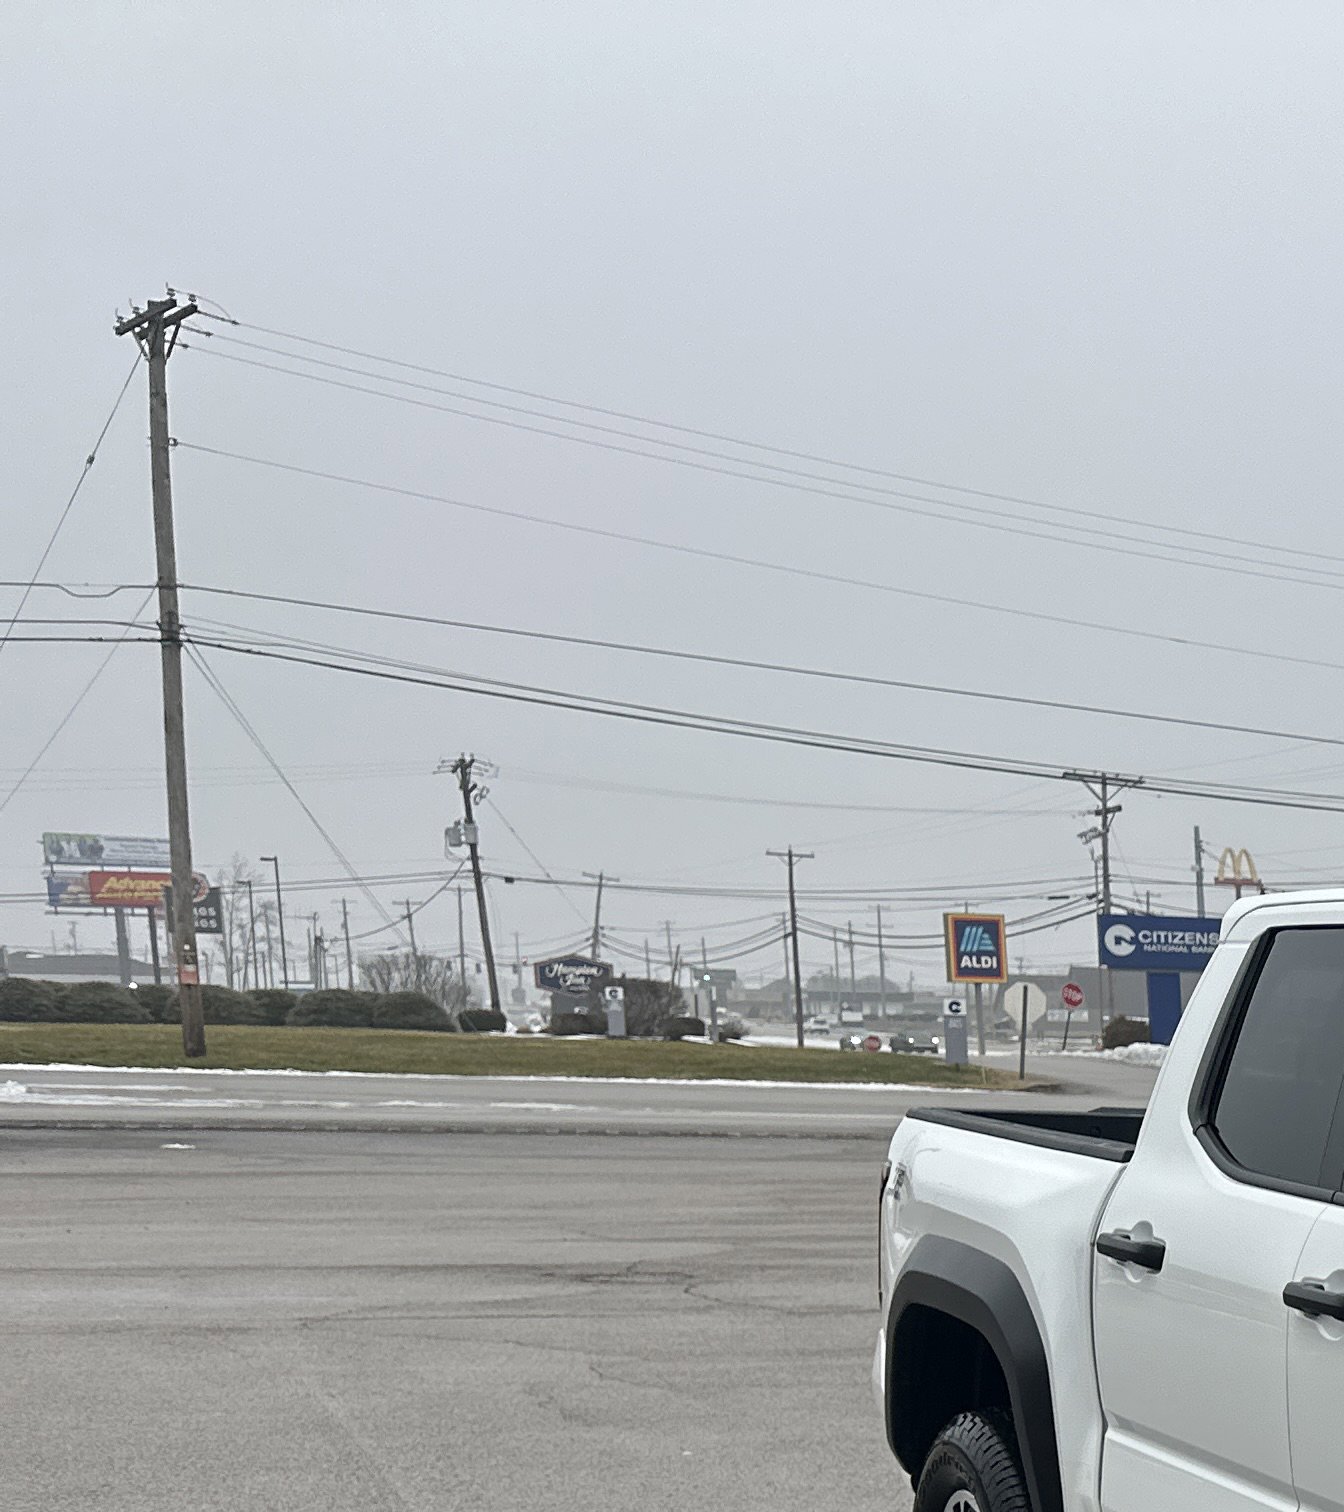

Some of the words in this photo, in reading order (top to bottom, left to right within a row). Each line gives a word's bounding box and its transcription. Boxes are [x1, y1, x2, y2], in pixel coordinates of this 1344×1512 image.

[1138, 930, 1219, 945] CITIZENS
[1143, 944, 1188, 953] NATIONAL
[960, 955, 998, 969] ALDI
